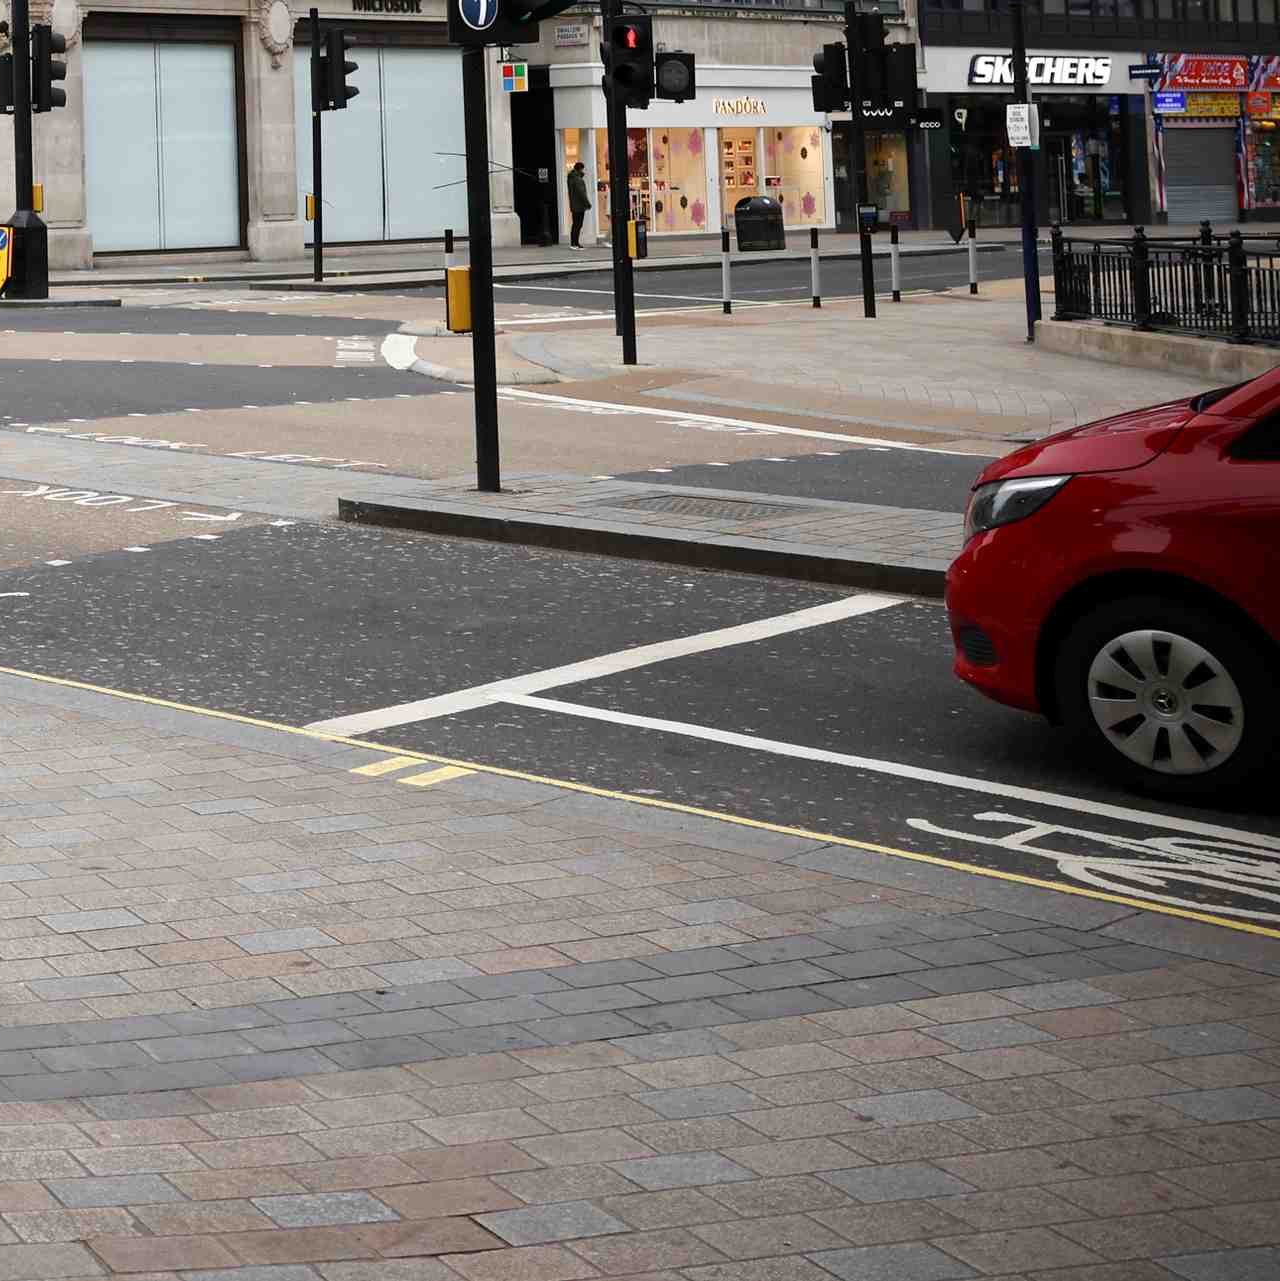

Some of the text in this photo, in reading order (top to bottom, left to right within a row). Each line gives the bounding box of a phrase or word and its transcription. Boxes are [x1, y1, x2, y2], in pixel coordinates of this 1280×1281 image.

[972, 56, 1112, 85] SKCHERS
[713, 96, 768, 115] PANDORA
[920, 121, 941, 129] ecco
